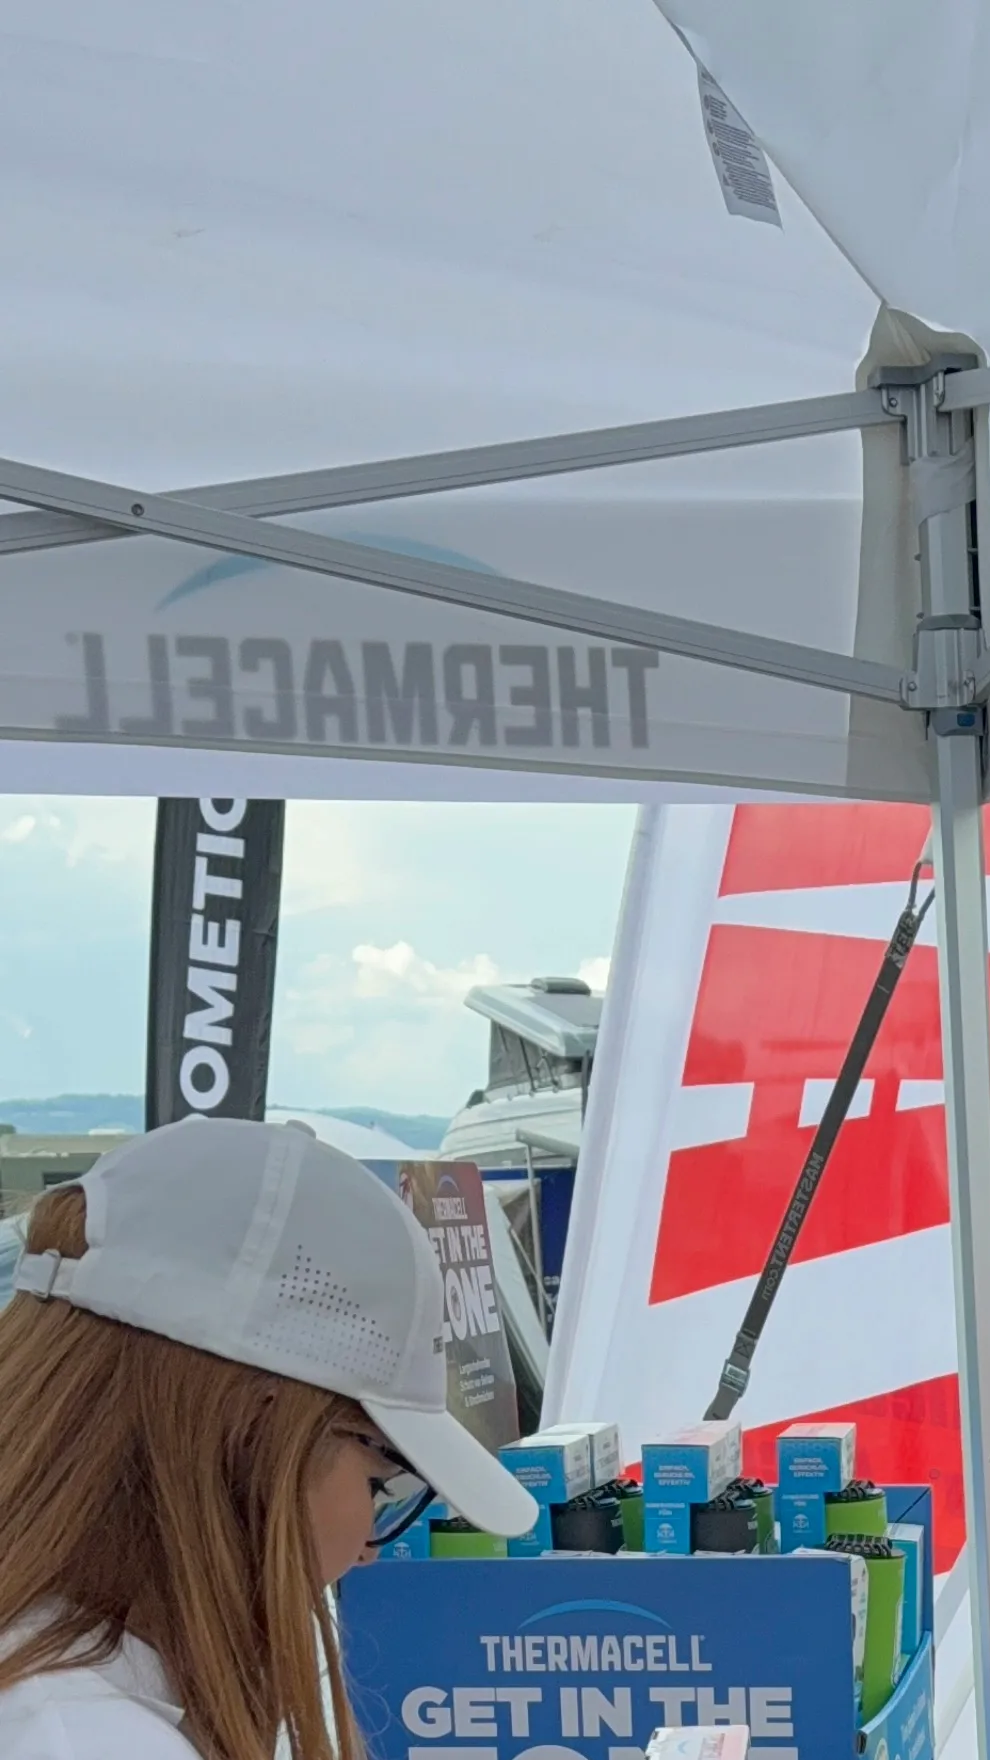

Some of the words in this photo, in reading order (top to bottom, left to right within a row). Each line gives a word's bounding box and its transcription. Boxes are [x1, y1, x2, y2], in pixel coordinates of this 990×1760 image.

[178, 797, 248, 1119] OMETIC
[428, 1227, 447, 1265] ET
[446, 1226, 462, 1263] IN
[461, 1224, 487, 1260] THE
[480, 1634, 713, 1672] THERMACELL
[401, 1686, 543, 1739] GET
[560, 1687, 633, 1738] IN
[649, 1687, 794, 1738] THE
